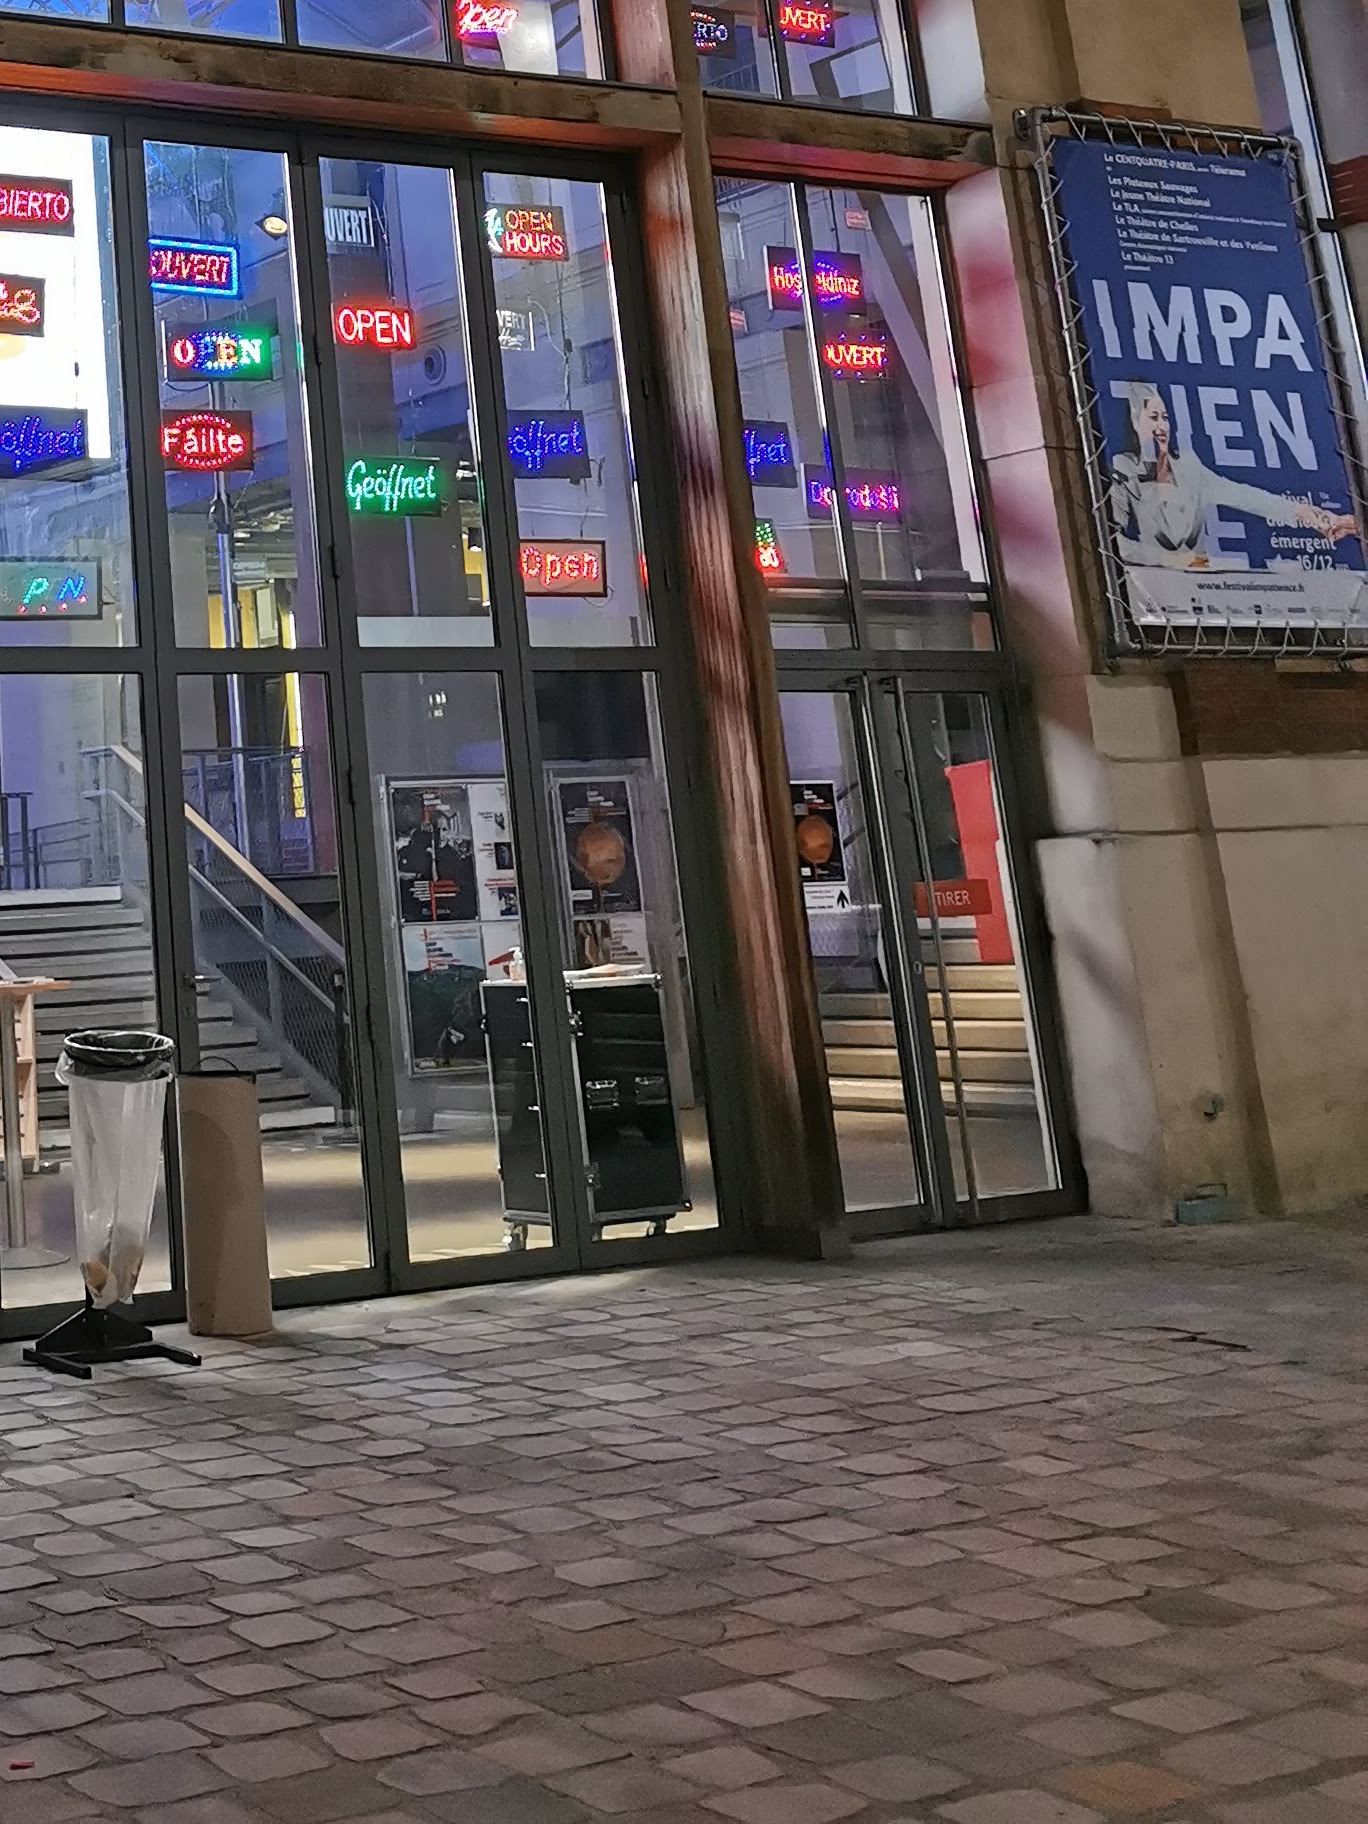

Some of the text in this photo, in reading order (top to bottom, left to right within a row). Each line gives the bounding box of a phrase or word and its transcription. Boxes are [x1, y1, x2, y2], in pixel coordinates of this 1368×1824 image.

[324, 206, 368, 245] UVERT
[505, 209, 554, 232] OPEN
[504, 231, 565, 256] HOURS
[150, 249, 230, 283] OUVERT
[337, 307, 412, 346] OPEN
[496, 308, 526, 332] VERT
[1091, 278, 1314, 373] IMPA
[162, 426, 244, 455] Fáilte
[507, 419, 583, 472] öffnet
[346, 459, 436, 512] Geöffnet
[1270, 532, 1337, 553] émergent
[520, 546, 599, 587] Open
[934, 891, 971, 907] TIRER
